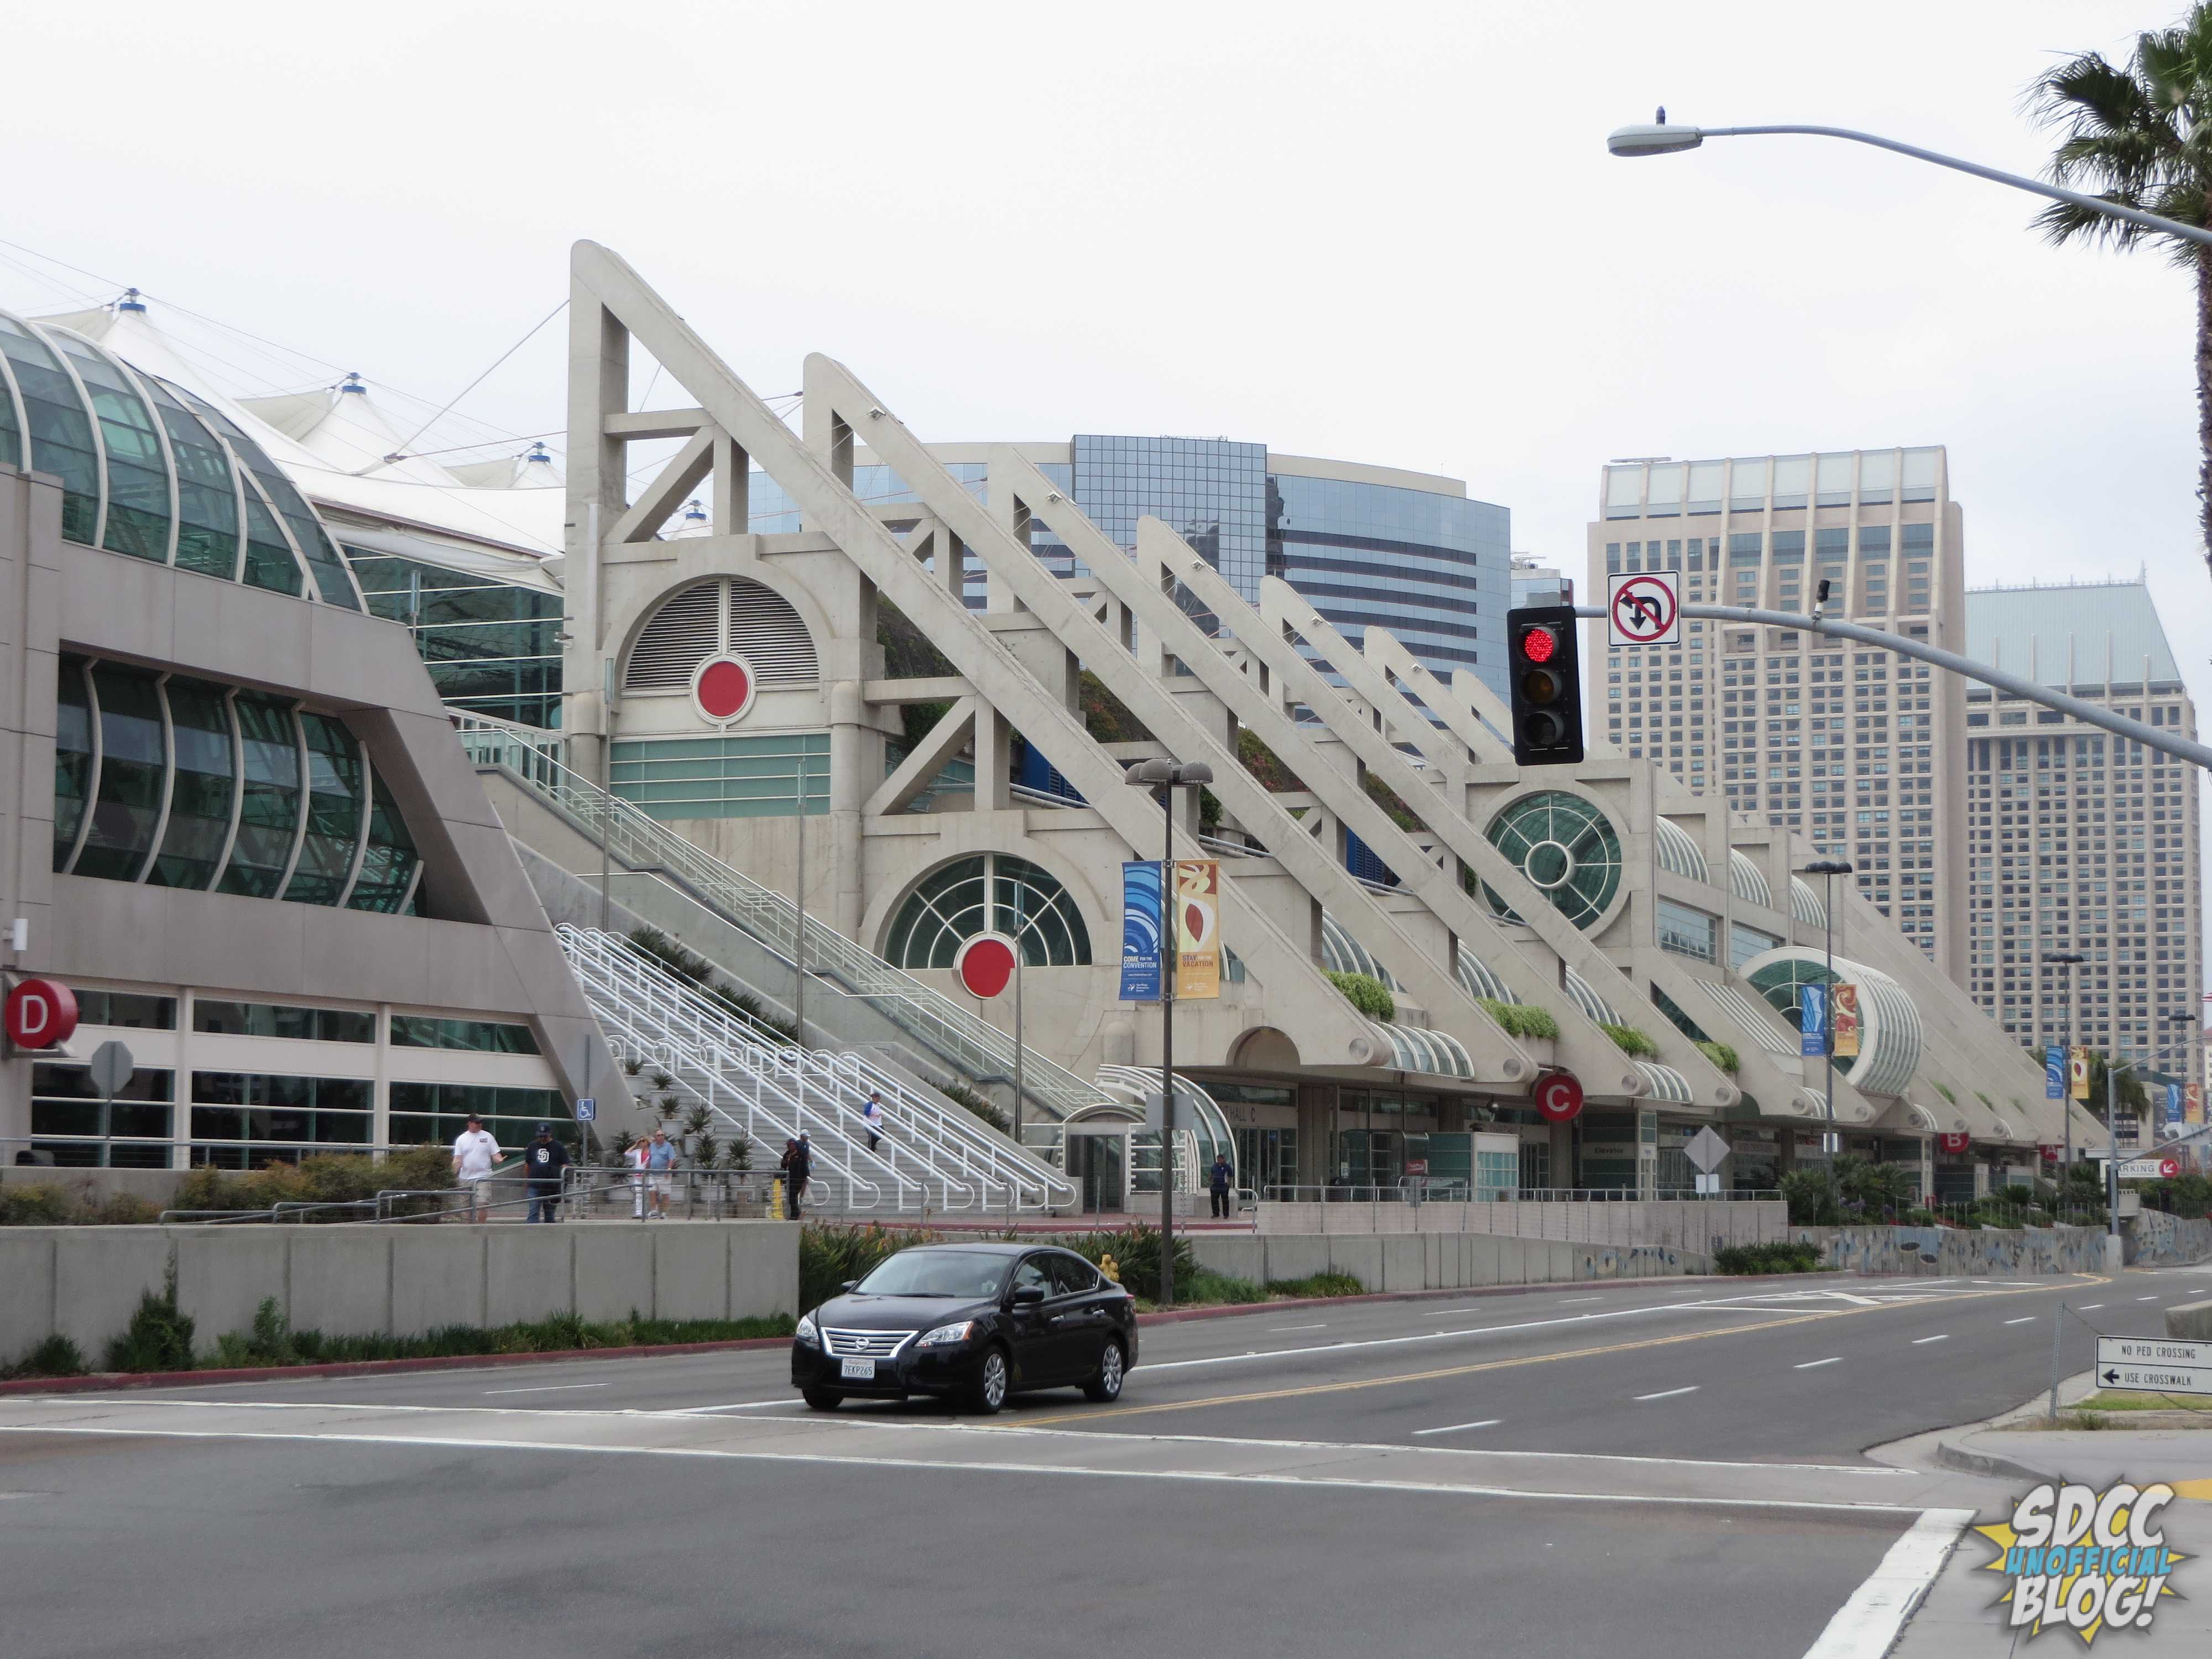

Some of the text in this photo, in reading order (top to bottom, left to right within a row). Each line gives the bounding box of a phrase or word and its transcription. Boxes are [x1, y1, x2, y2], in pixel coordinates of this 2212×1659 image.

[20, 995, 49, 1034] D
[1546, 1084, 1571, 1112] C
[1947, 1134, 1961, 1147] B
[2121, 1345, 2195, 1359] NO PED CROSSING
[844, 1365, 873, 1376] 7EKP265
[2125, 1373, 2192, 1386] USE CROSSWALK
